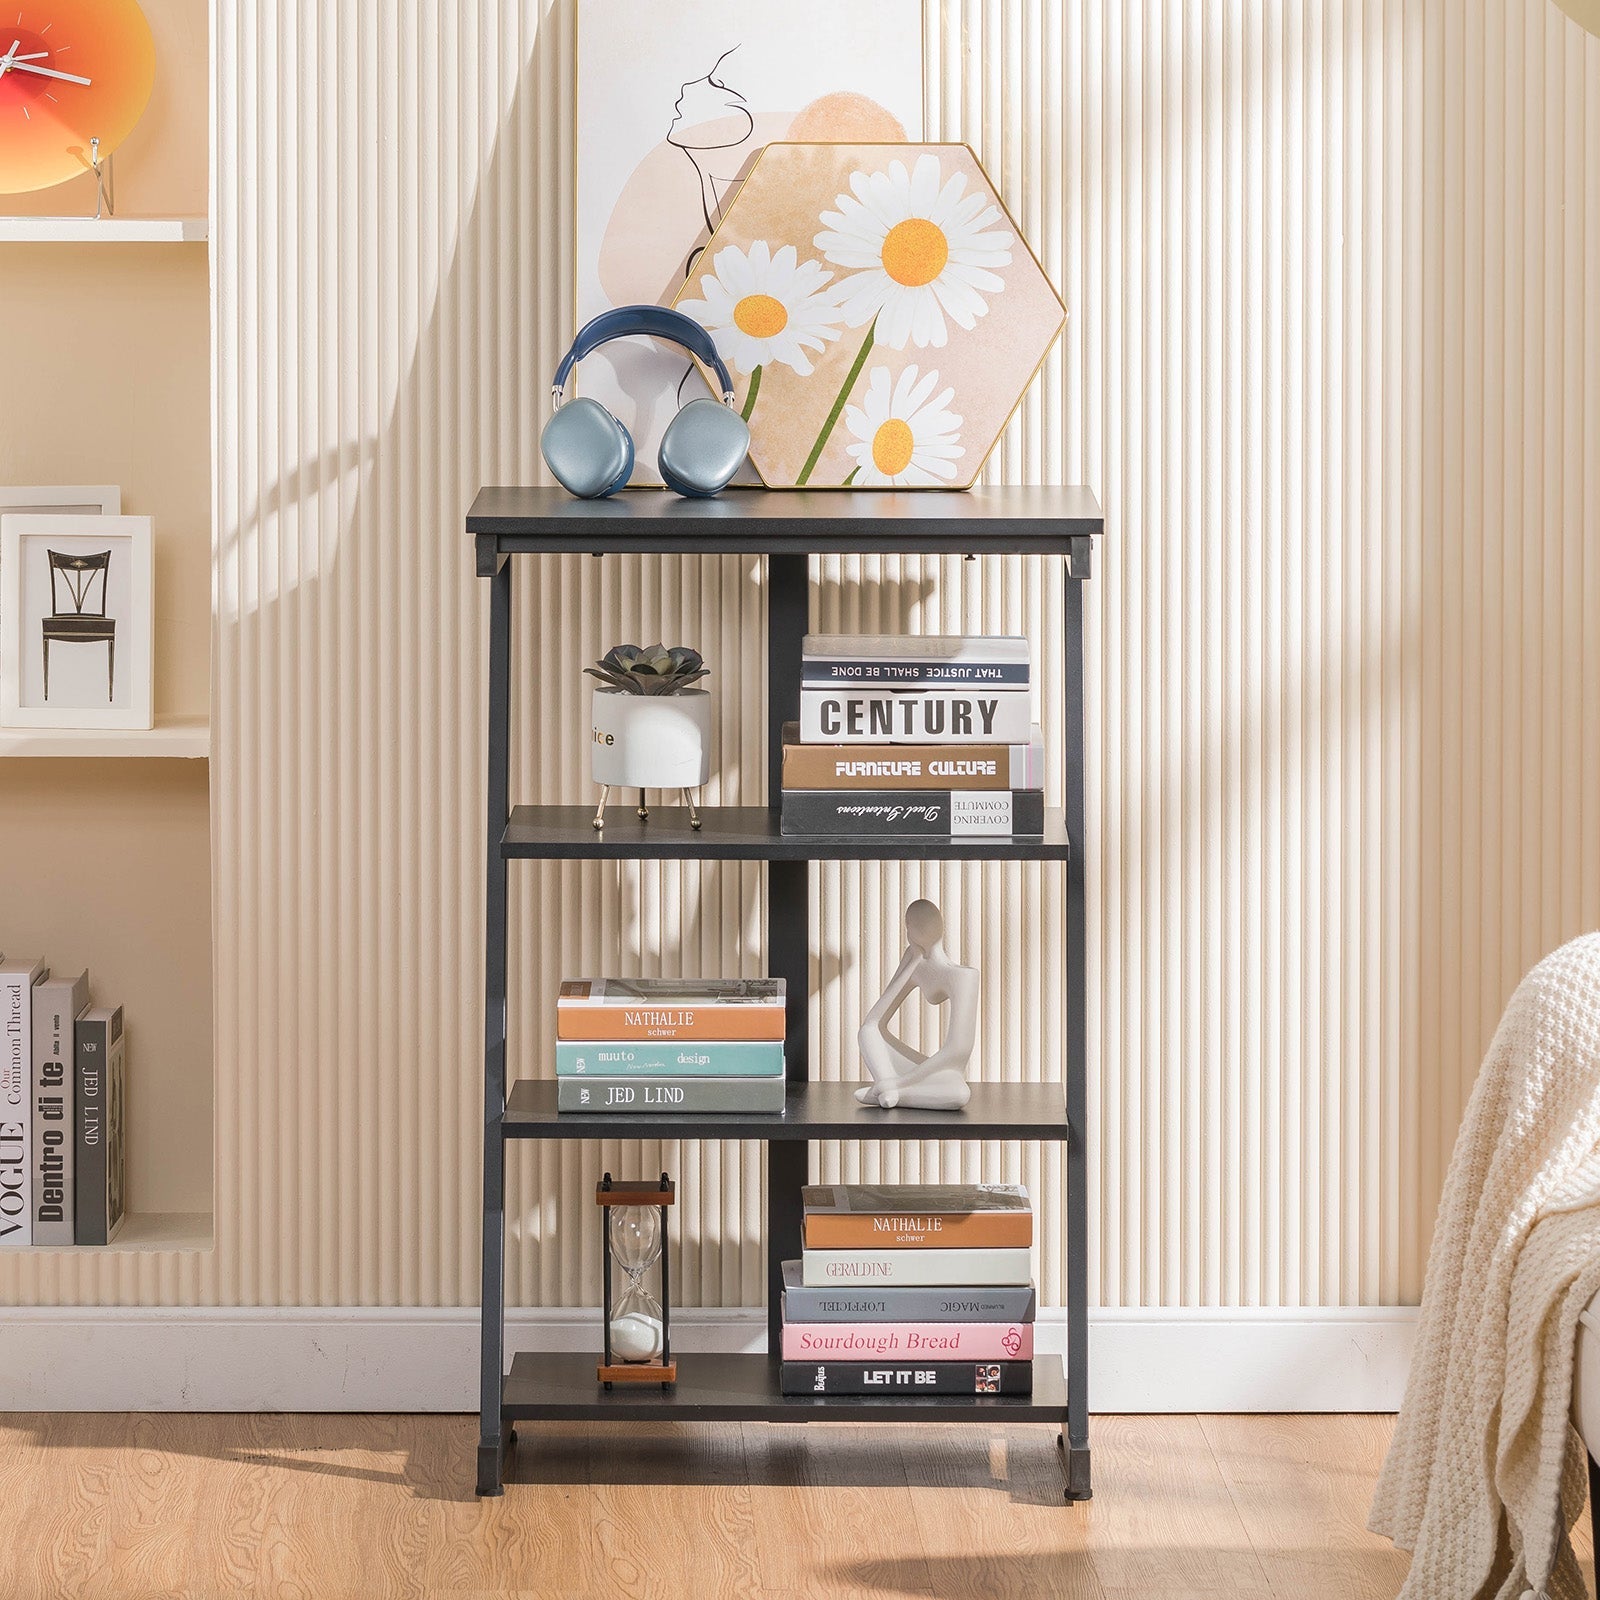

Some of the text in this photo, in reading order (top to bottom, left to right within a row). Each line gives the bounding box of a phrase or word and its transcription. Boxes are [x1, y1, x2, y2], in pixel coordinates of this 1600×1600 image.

[831, 666, 1003, 678] THAT JUSTICE SHALL BE DONE
[820, 699, 999, 736] CENTURY
[592, 726, 615, 746] ice
[835, 760, 996, 776] FURNITURE CULTURE
[954, 801, 1010, 810] COMMUTE
[954, 814, 1010, 824] COVERING
[624, 1012, 694, 1026] NATHALIE
[647, 1028, 676, 1036] schwer
[7, 984, 22, 1106] Common Thread
[598, 1052, 710, 1064] muuto design
[0, 1068, 10, 1089] Our
[40, 1062, 64, 1088] te
[605, 1087, 684, 1105] JED LIND
[38, 1096, 64, 1121] di
[83, 1067, 99, 1146] JED LIND
[0, 1122, 24, 1237] VOGUE
[38, 1130, 64, 1222] Dentro
[873, 1218, 943, 1232] NATHALIE
[896, 1234, 926, 1242] schwer
[826, 1262, 892, 1277] GERALDINE
[819, 1301, 886, 1312] L'OFFICIEL
[940, 1302, 980, 1312] MAGIC
[800, 1332, 961, 1354] Sourdough Bread
[863, 1370, 936, 1385] LET IT BE
